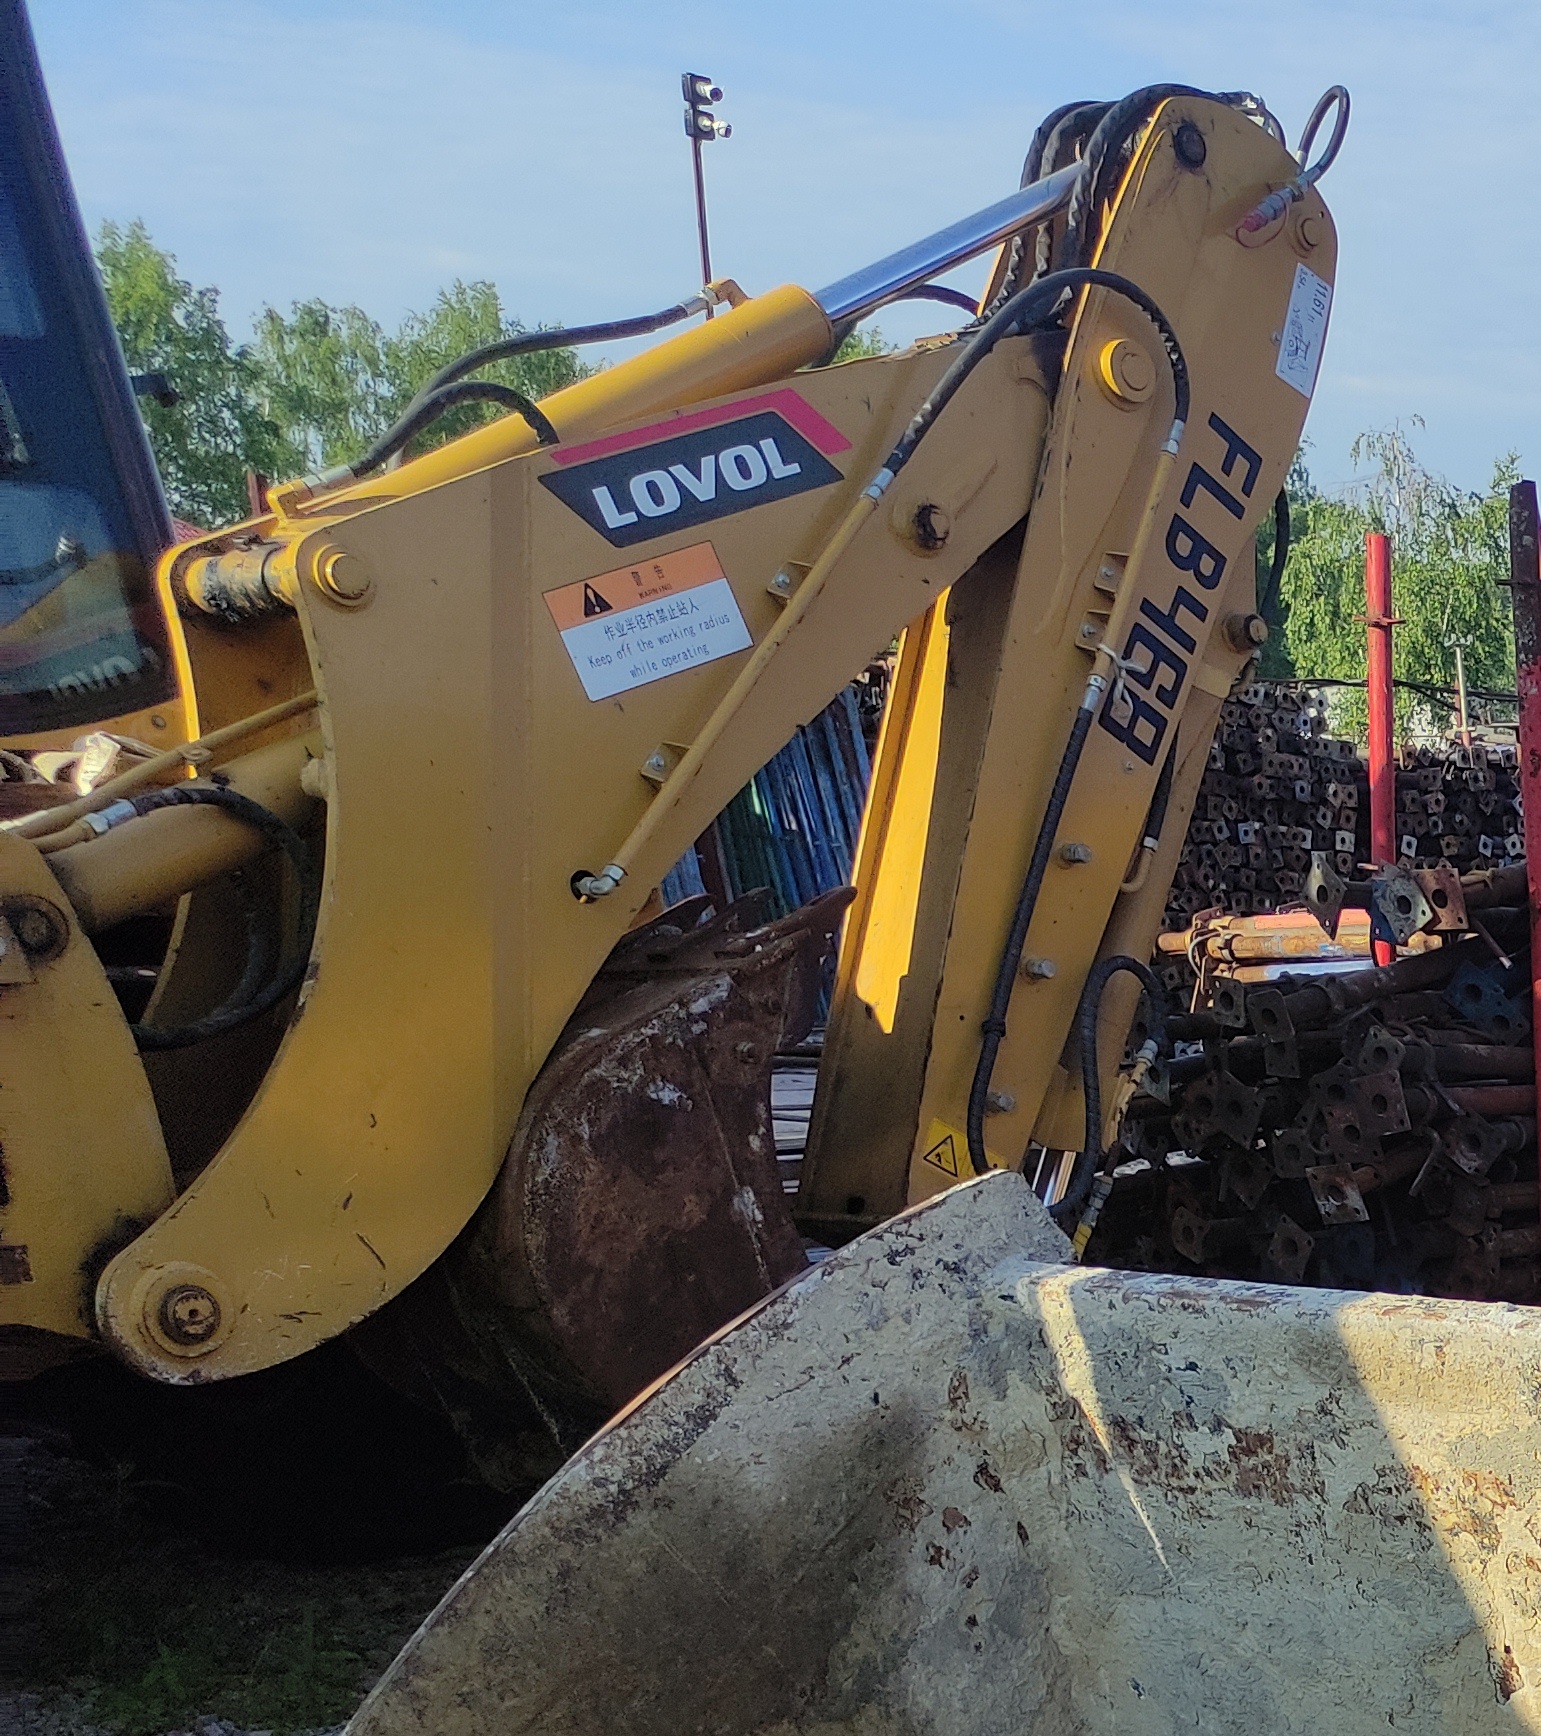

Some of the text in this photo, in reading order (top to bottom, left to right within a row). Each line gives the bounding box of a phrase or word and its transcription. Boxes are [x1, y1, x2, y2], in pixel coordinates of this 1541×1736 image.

[592, 438, 801, 529] LOVOL
[1098, 411, 1263, 767] FLB468
[587, 613, 731, 669] Keep off the working radius
[604, 598, 699, 641] 作业半径内禁止站人
[630, 643, 710, 679] while operating
